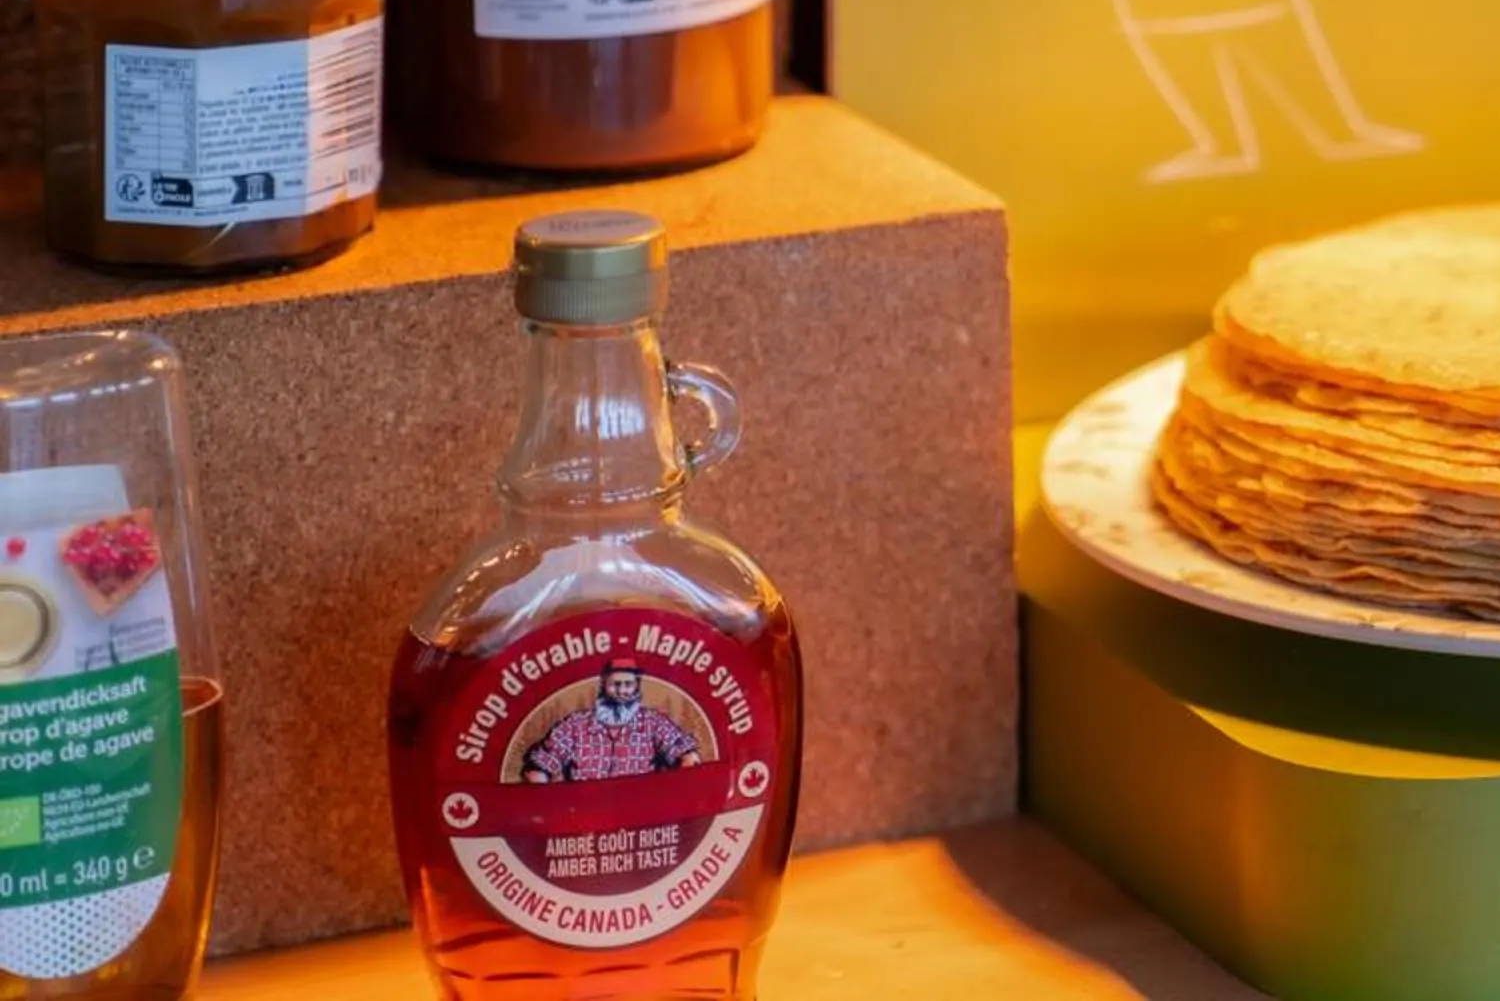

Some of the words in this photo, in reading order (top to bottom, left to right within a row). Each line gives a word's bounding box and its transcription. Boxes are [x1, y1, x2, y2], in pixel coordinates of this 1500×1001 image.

[456, 693, 508, 763] Sirop
[501, 627, 611, 696] d'érable
[635, 623, 713, 672] Maple
[709, 666, 753, 734] syrup
[45, 708, 129, 737] d'agave
[59, 740, 88, 762] de
[93, 726, 154, 756] agave
[545, 832, 595, 857] AMBRÉ
[598, 828, 636, 853] GOÛT
[639, 824, 679, 848] RICHE
[19, 868, 48, 894] ml
[73, 855, 110, 885] 340
[116, 857, 128, 881] g
[477, 851, 557, 923] ORIGINE
[557, 903, 653, 934] CANADA
[667, 843, 731, 910] GRADE
[722, 824, 743, 843] A
[547, 857, 597, 878] AMBER
[601, 852, 633, 874] RICH
[637, 846, 678, 869] TASTE
